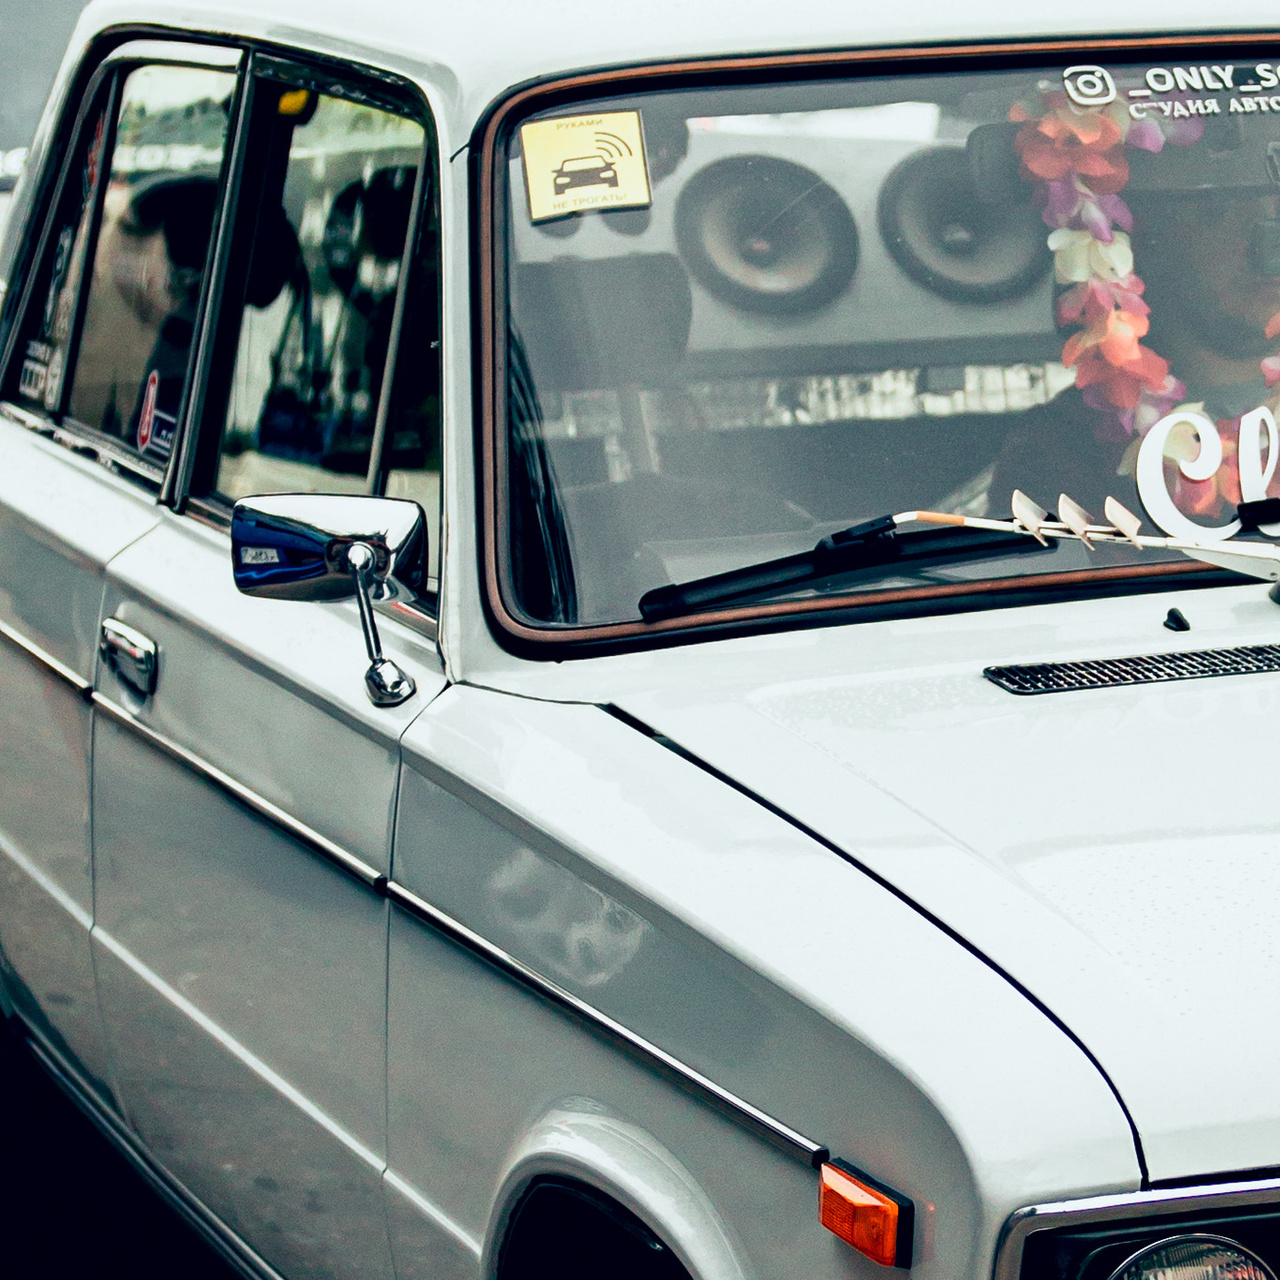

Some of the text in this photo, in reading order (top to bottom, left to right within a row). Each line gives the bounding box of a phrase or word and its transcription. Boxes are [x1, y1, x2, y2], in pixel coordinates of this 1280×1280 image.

[556, 119, 603, 130] РУКАМИ
[553, 194, 627, 210] НЕ ТРОГАТЬ!
